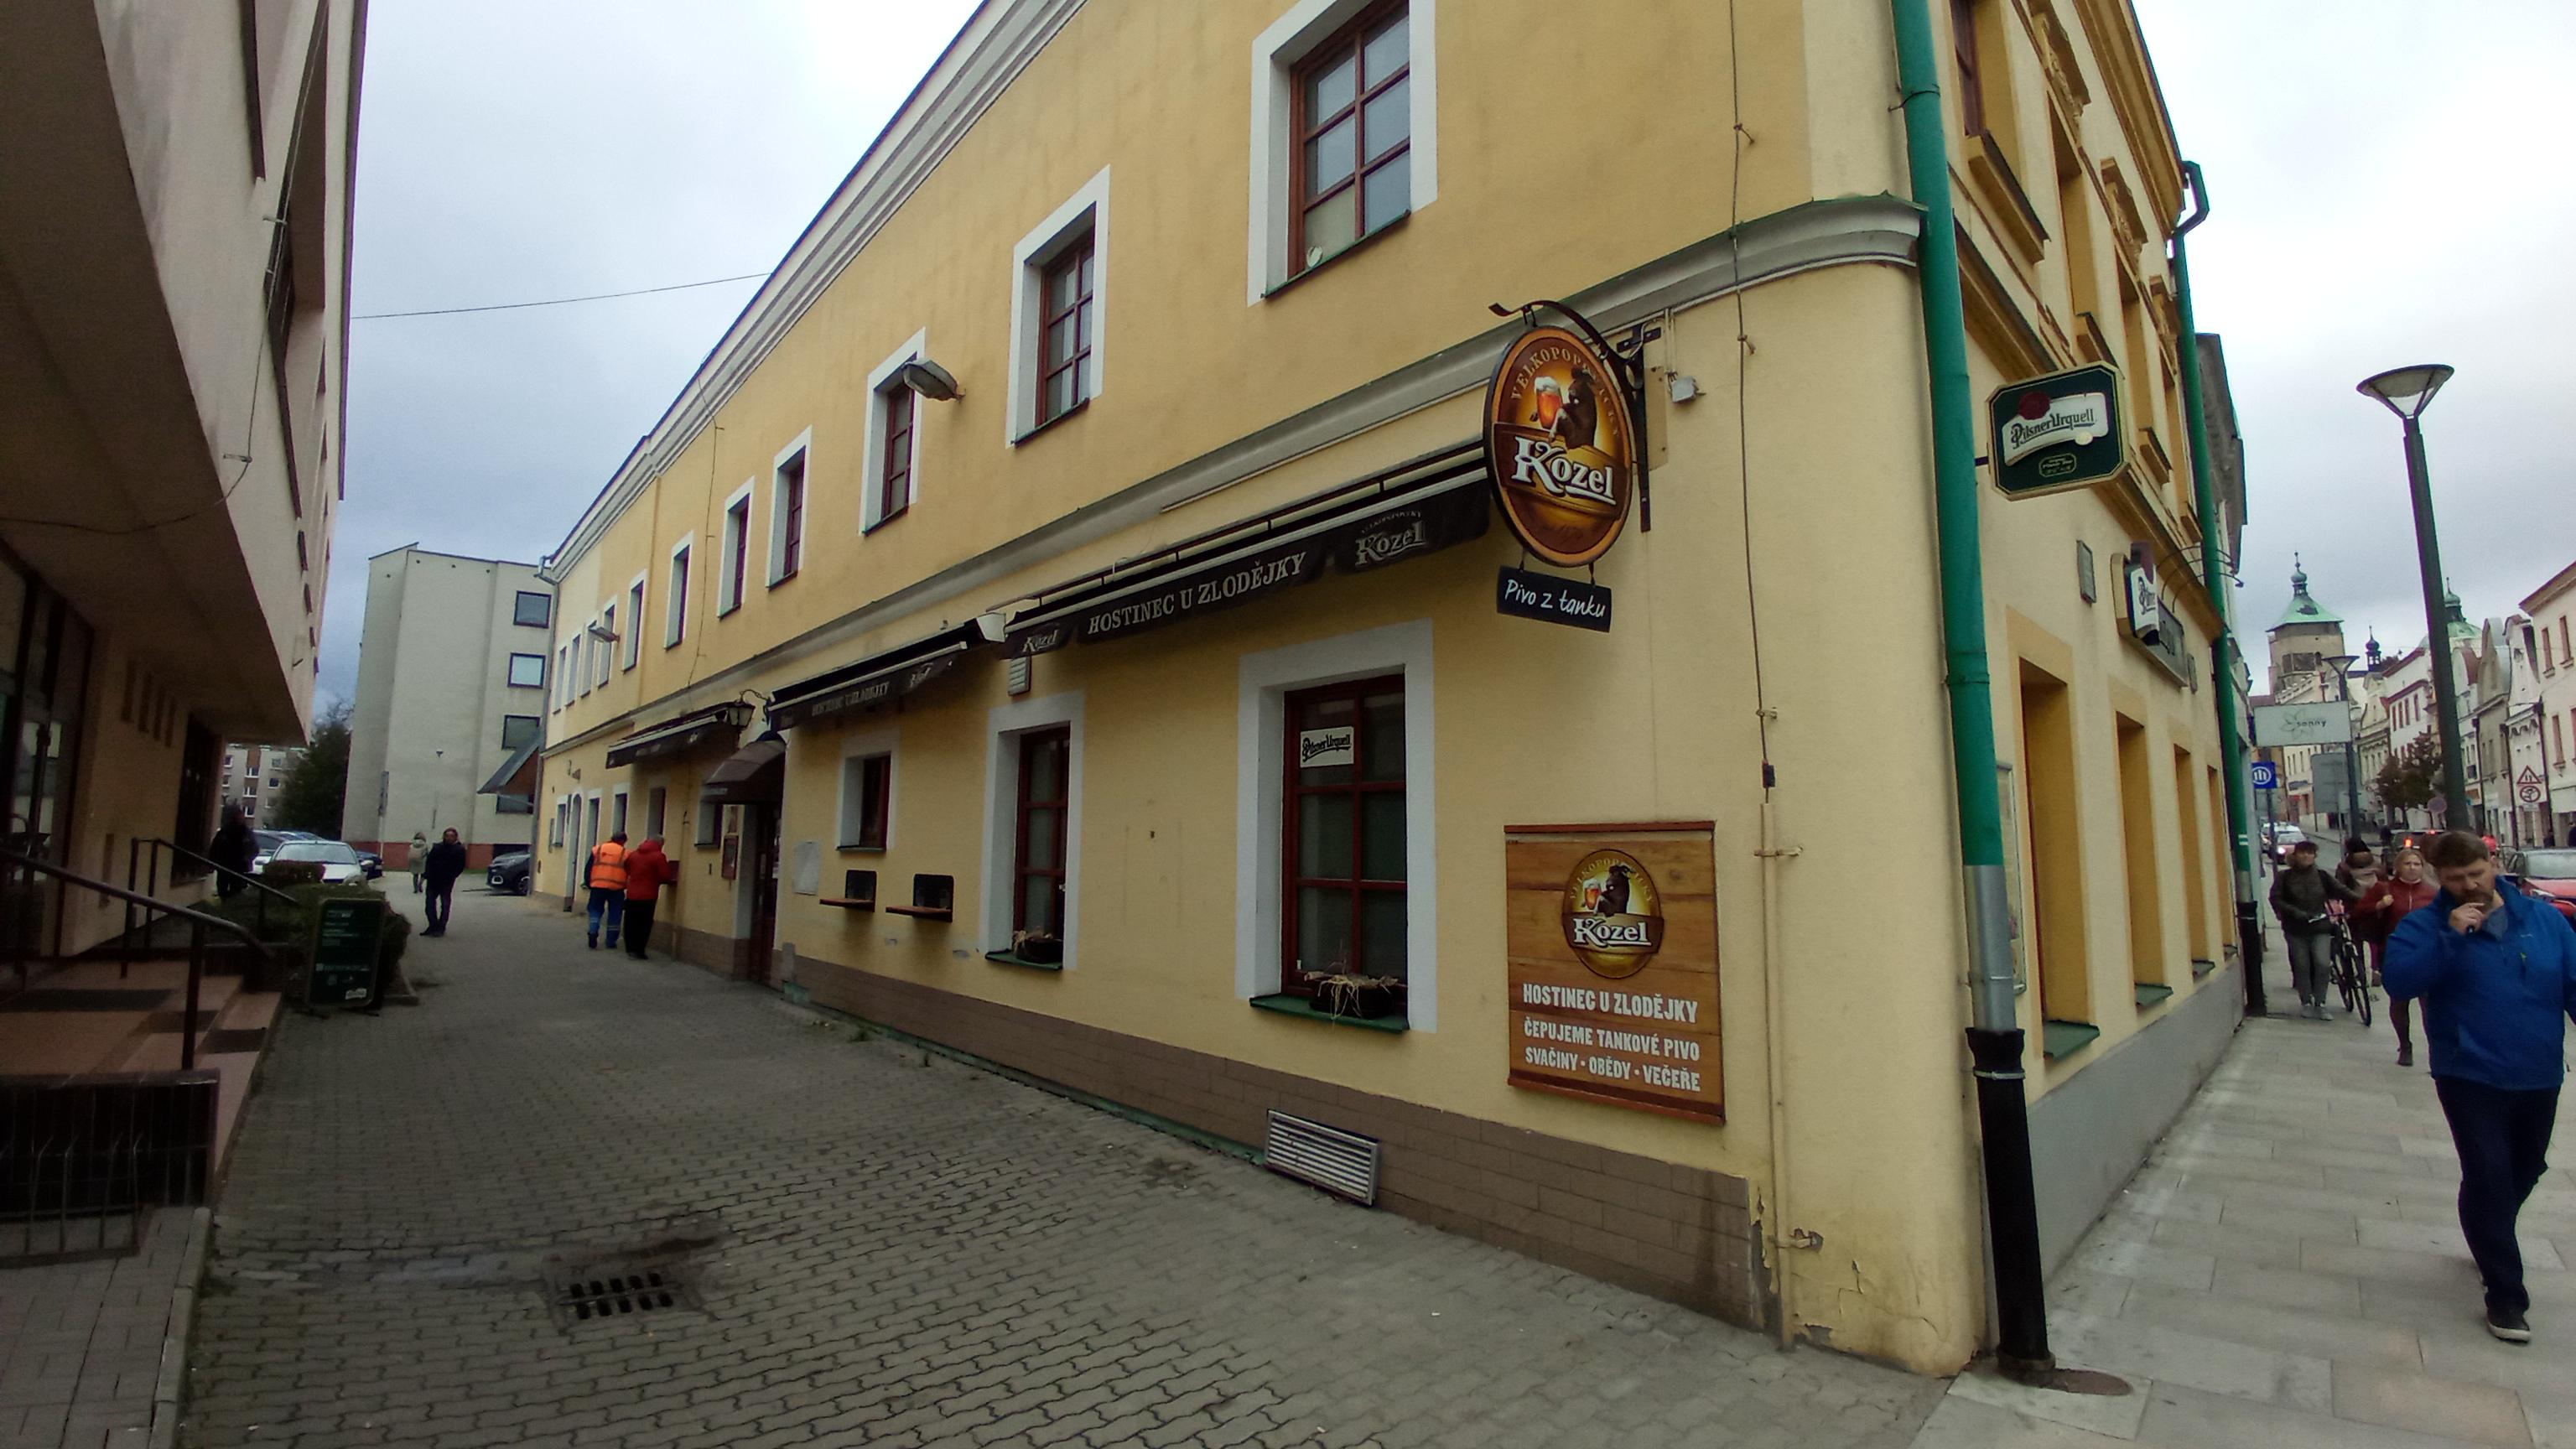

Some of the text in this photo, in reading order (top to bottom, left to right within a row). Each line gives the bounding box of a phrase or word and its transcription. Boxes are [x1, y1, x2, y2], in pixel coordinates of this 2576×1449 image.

[2010, 408, 2095, 450] Pilsner Urquell
[1511, 436, 1615, 504] Kozel
[1355, 521, 1425, 568] Kozel
[1088, 551, 1306, 635] HOSTINEC U ZLODĚJKY
[1504, 579, 1606, 619] Pivo z tanku
[1573, 917, 1652, 947] Kozel
[1523, 983, 1697, 1023] HOSTINEC U ZLODĚJKY
[1524, 1016, 1700, 1062] ČEPUJEME TANKOVÉ PIVO
[1524, 1046, 1701, 1092] SVAČINY OBĚDY VEČEŘE
